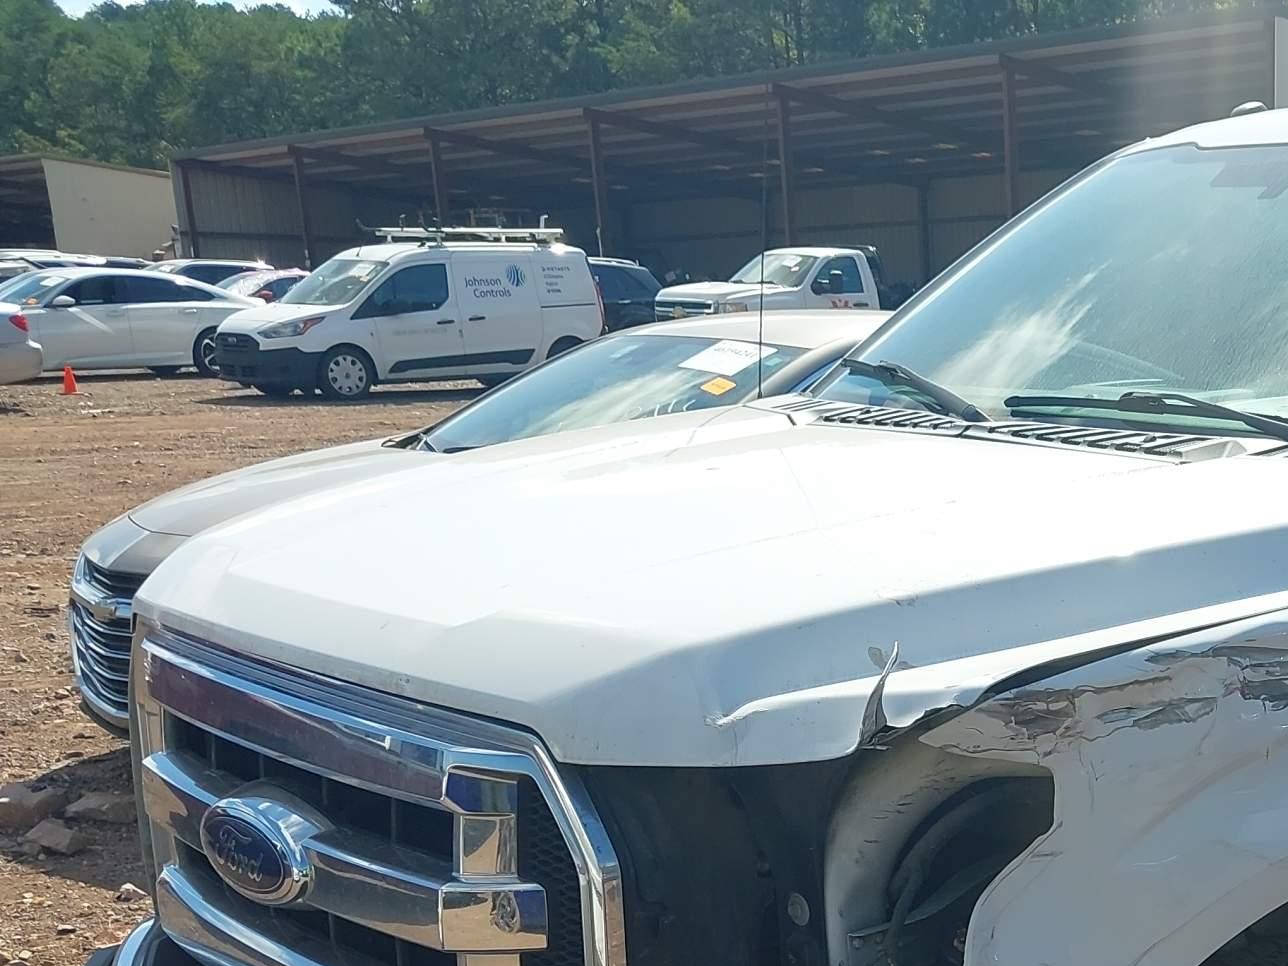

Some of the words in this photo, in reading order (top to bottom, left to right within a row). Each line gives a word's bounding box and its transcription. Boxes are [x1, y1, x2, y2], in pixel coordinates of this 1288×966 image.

[464, 277, 502, 288] Johnson
[473, 288, 512, 299] Controls
[216, 825, 264, 882] Ford
